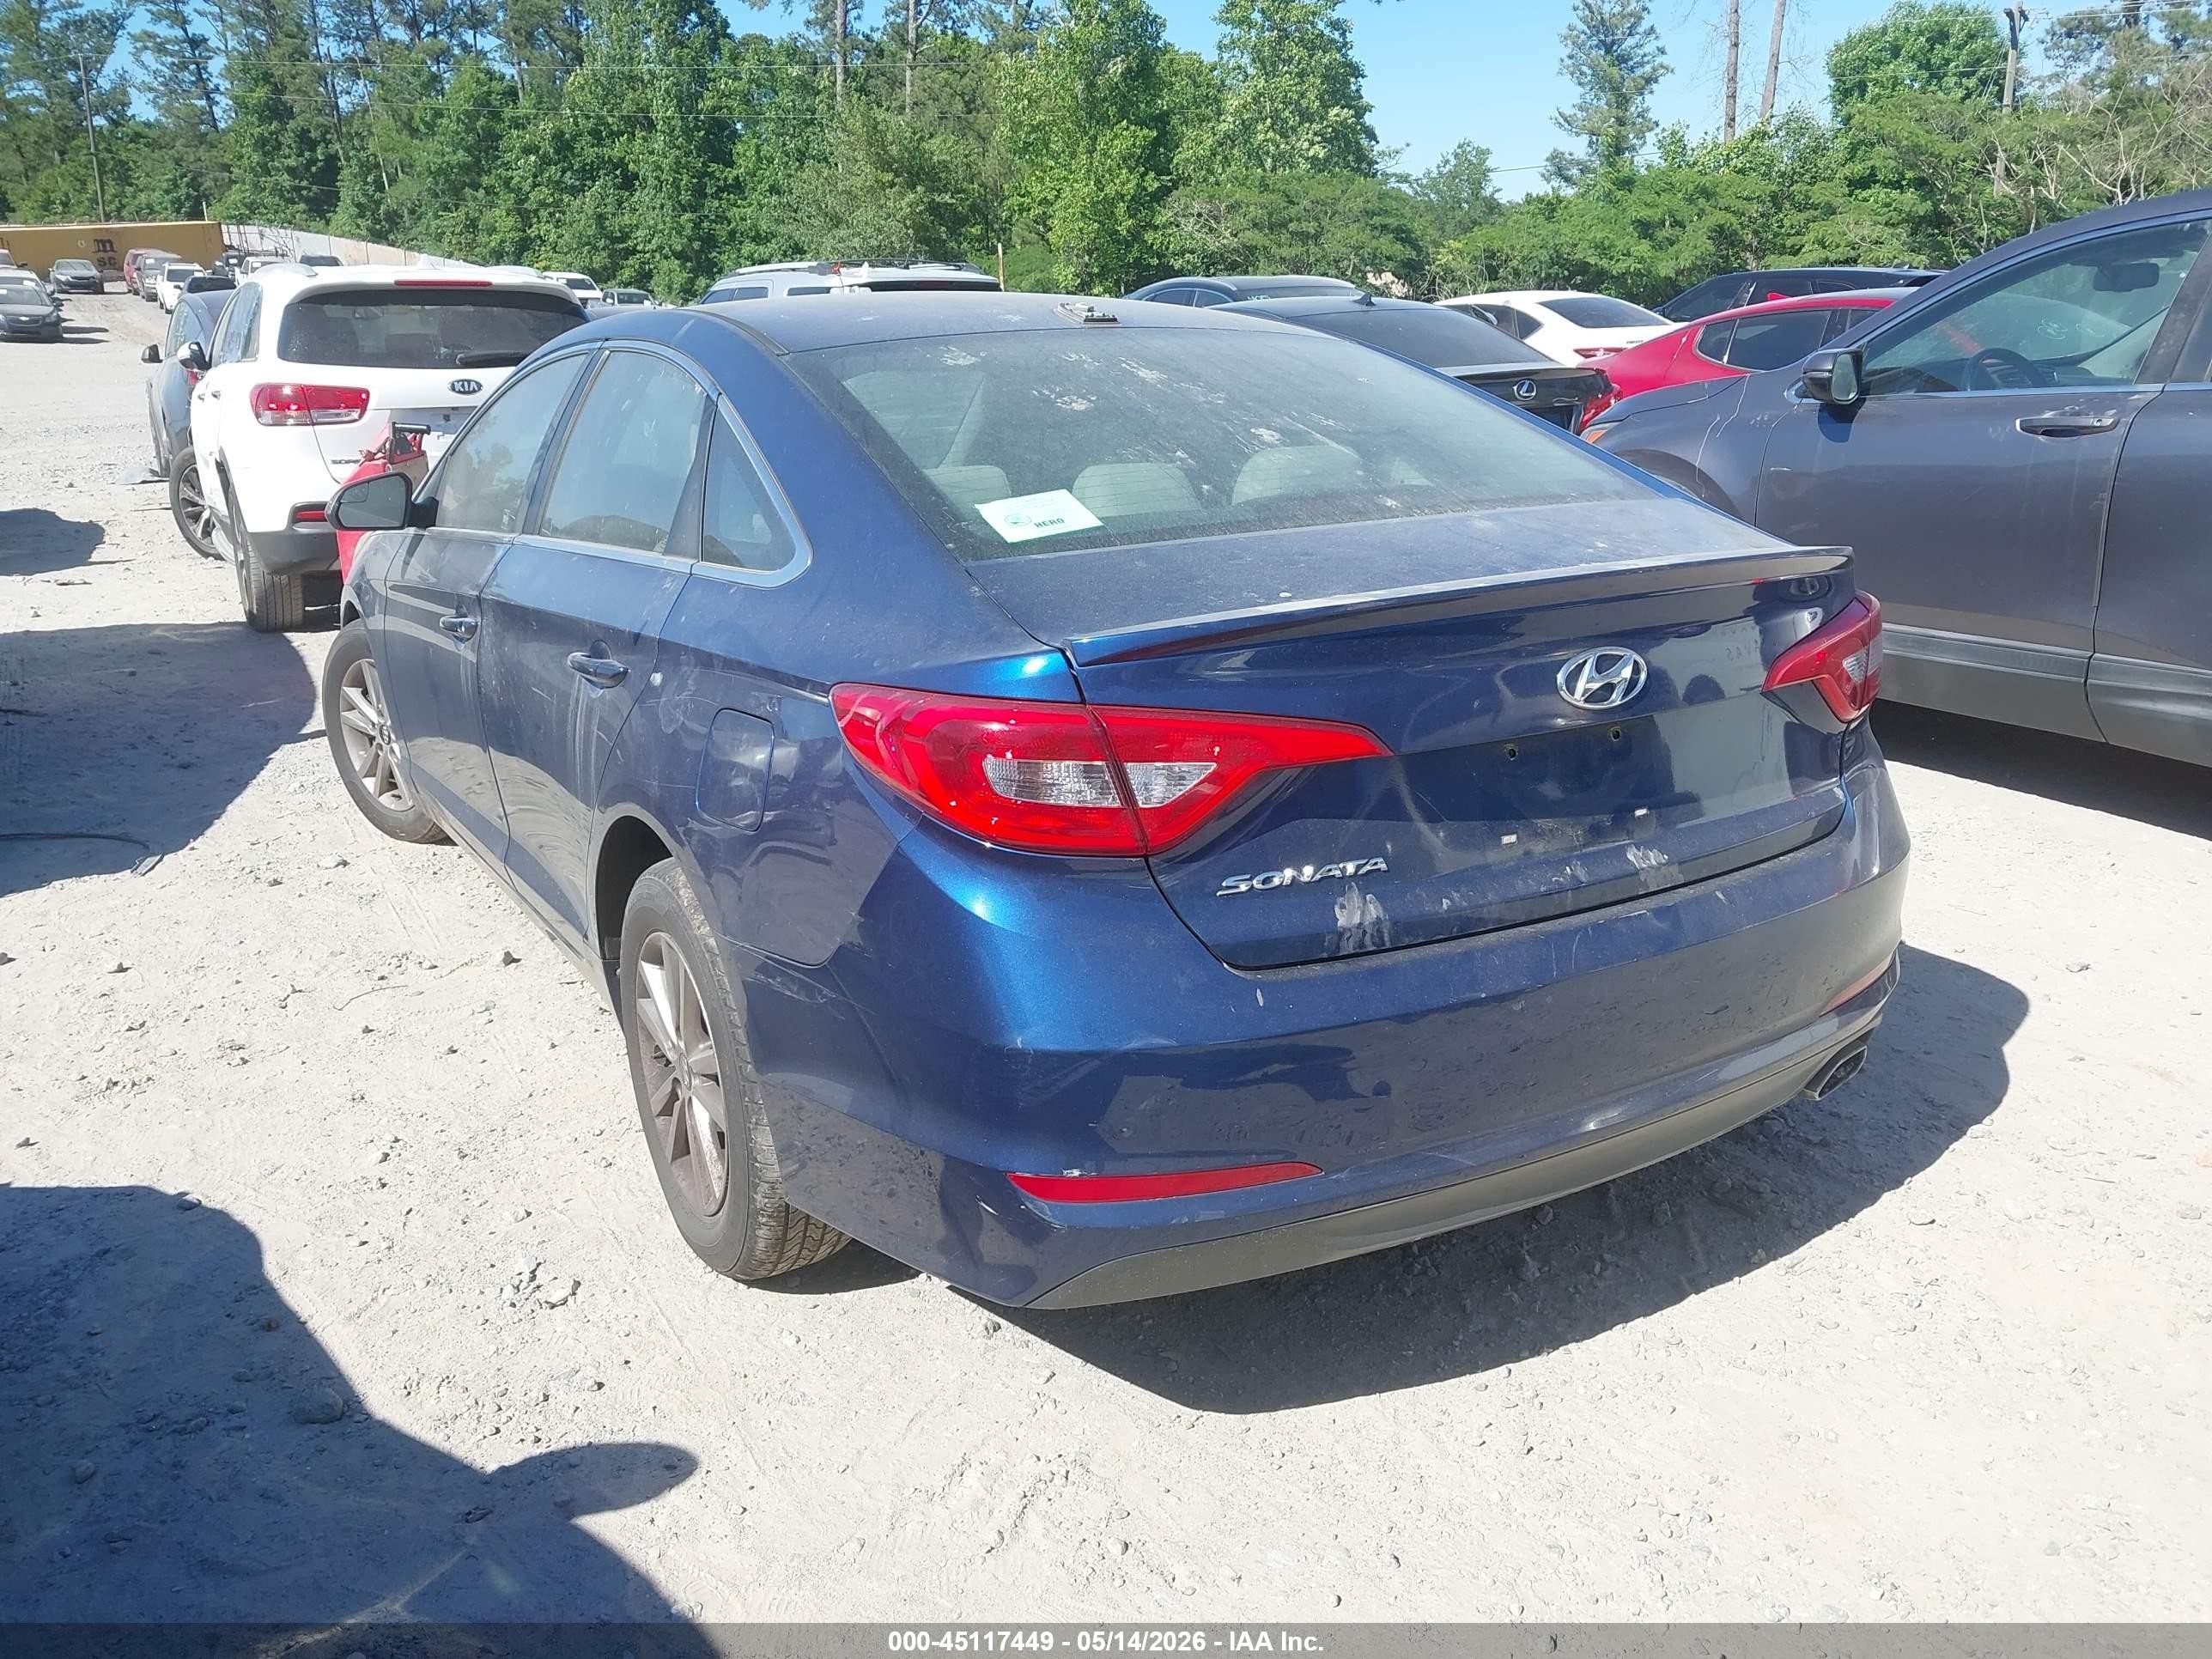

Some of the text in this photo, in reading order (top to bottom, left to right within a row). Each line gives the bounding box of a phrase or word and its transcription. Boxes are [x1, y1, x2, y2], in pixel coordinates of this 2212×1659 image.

[453, 380, 478, 392] KIA
[1035, 518, 1065, 528] HERO
[1216, 856, 1389, 896] SONATA
